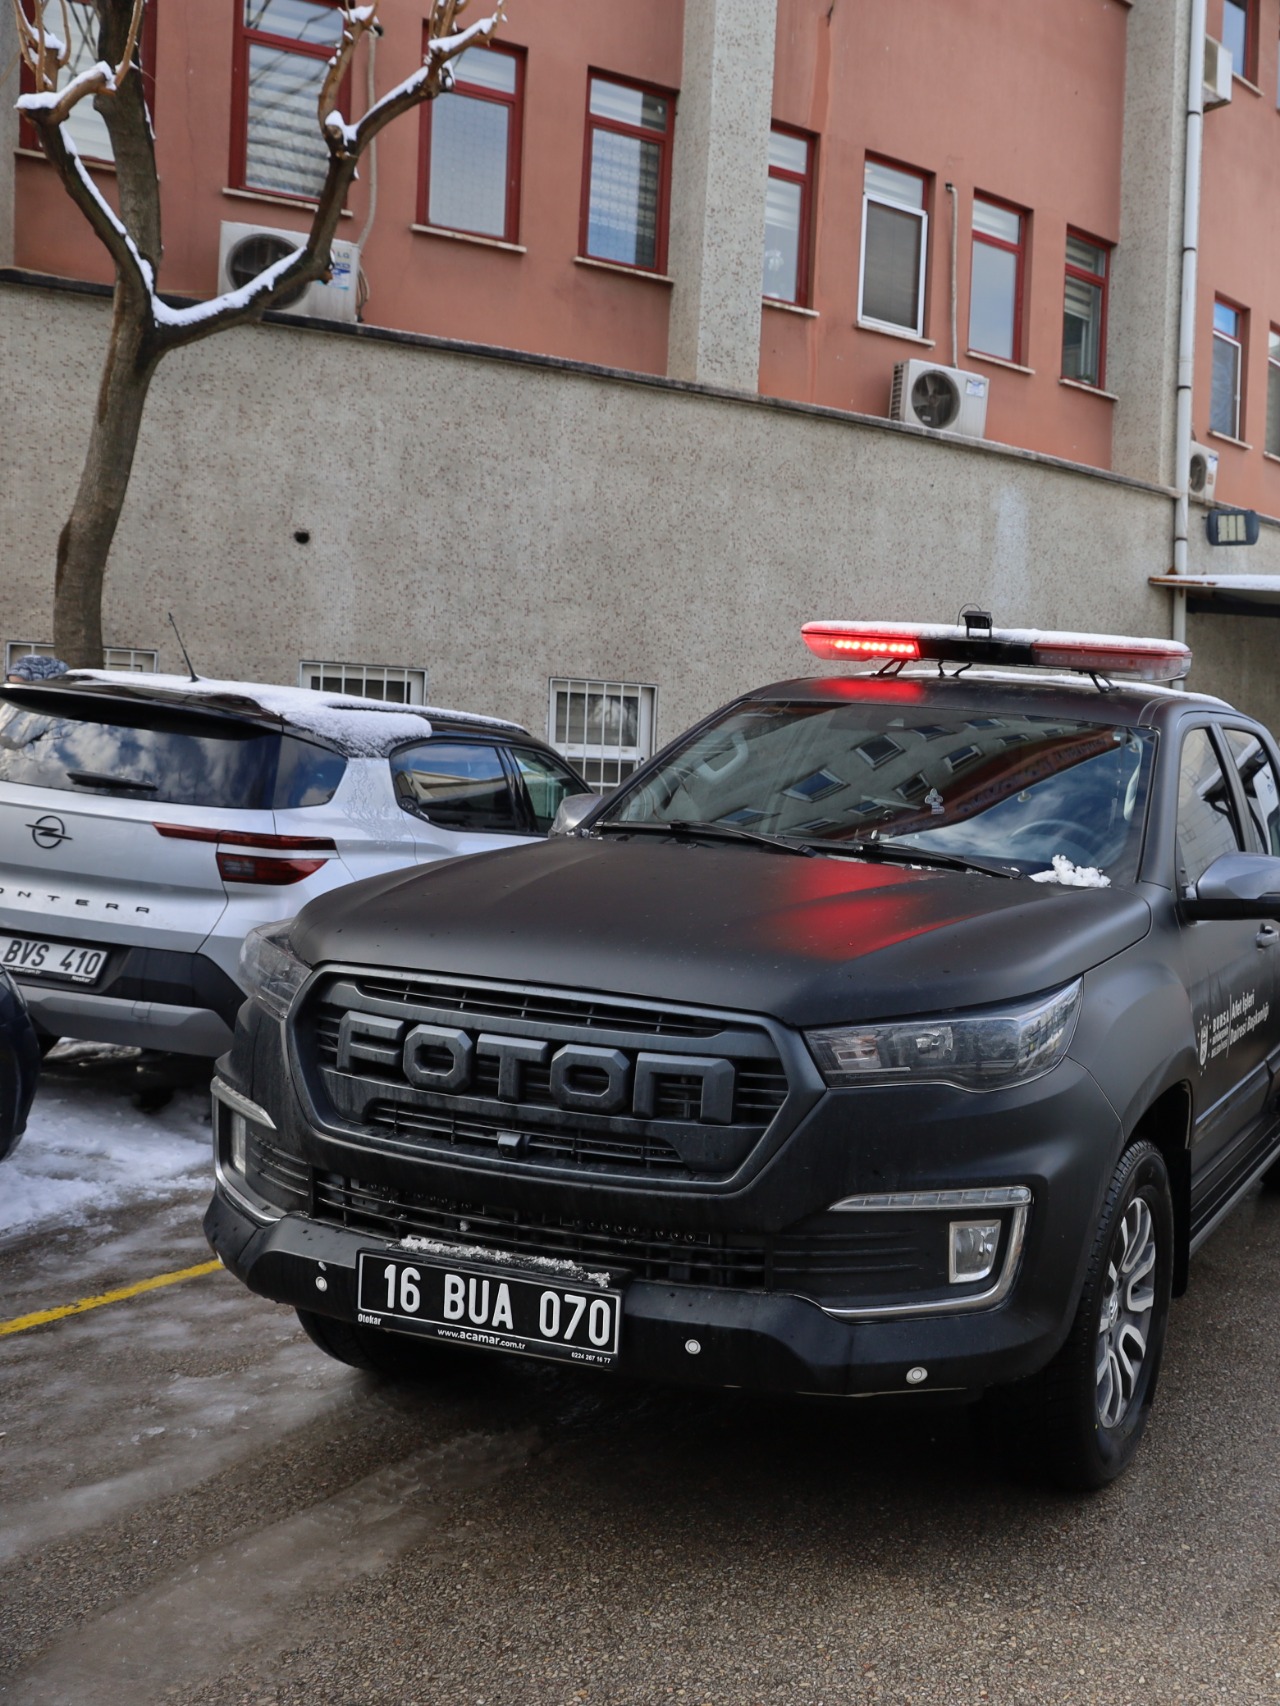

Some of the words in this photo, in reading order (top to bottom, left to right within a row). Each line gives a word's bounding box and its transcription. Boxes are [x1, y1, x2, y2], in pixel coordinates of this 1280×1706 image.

[3, 940, 50, 967] BVS
[60, 949, 102, 975] 410
[358, 1313, 381, 1325] Otokar
[384, 1264, 421, 1313] 16
[443, 1273, 514, 1330] BUA
[539, 1290, 611, 1347] 070
[437, 1327, 526, 1350] www.acamar.com.tr
